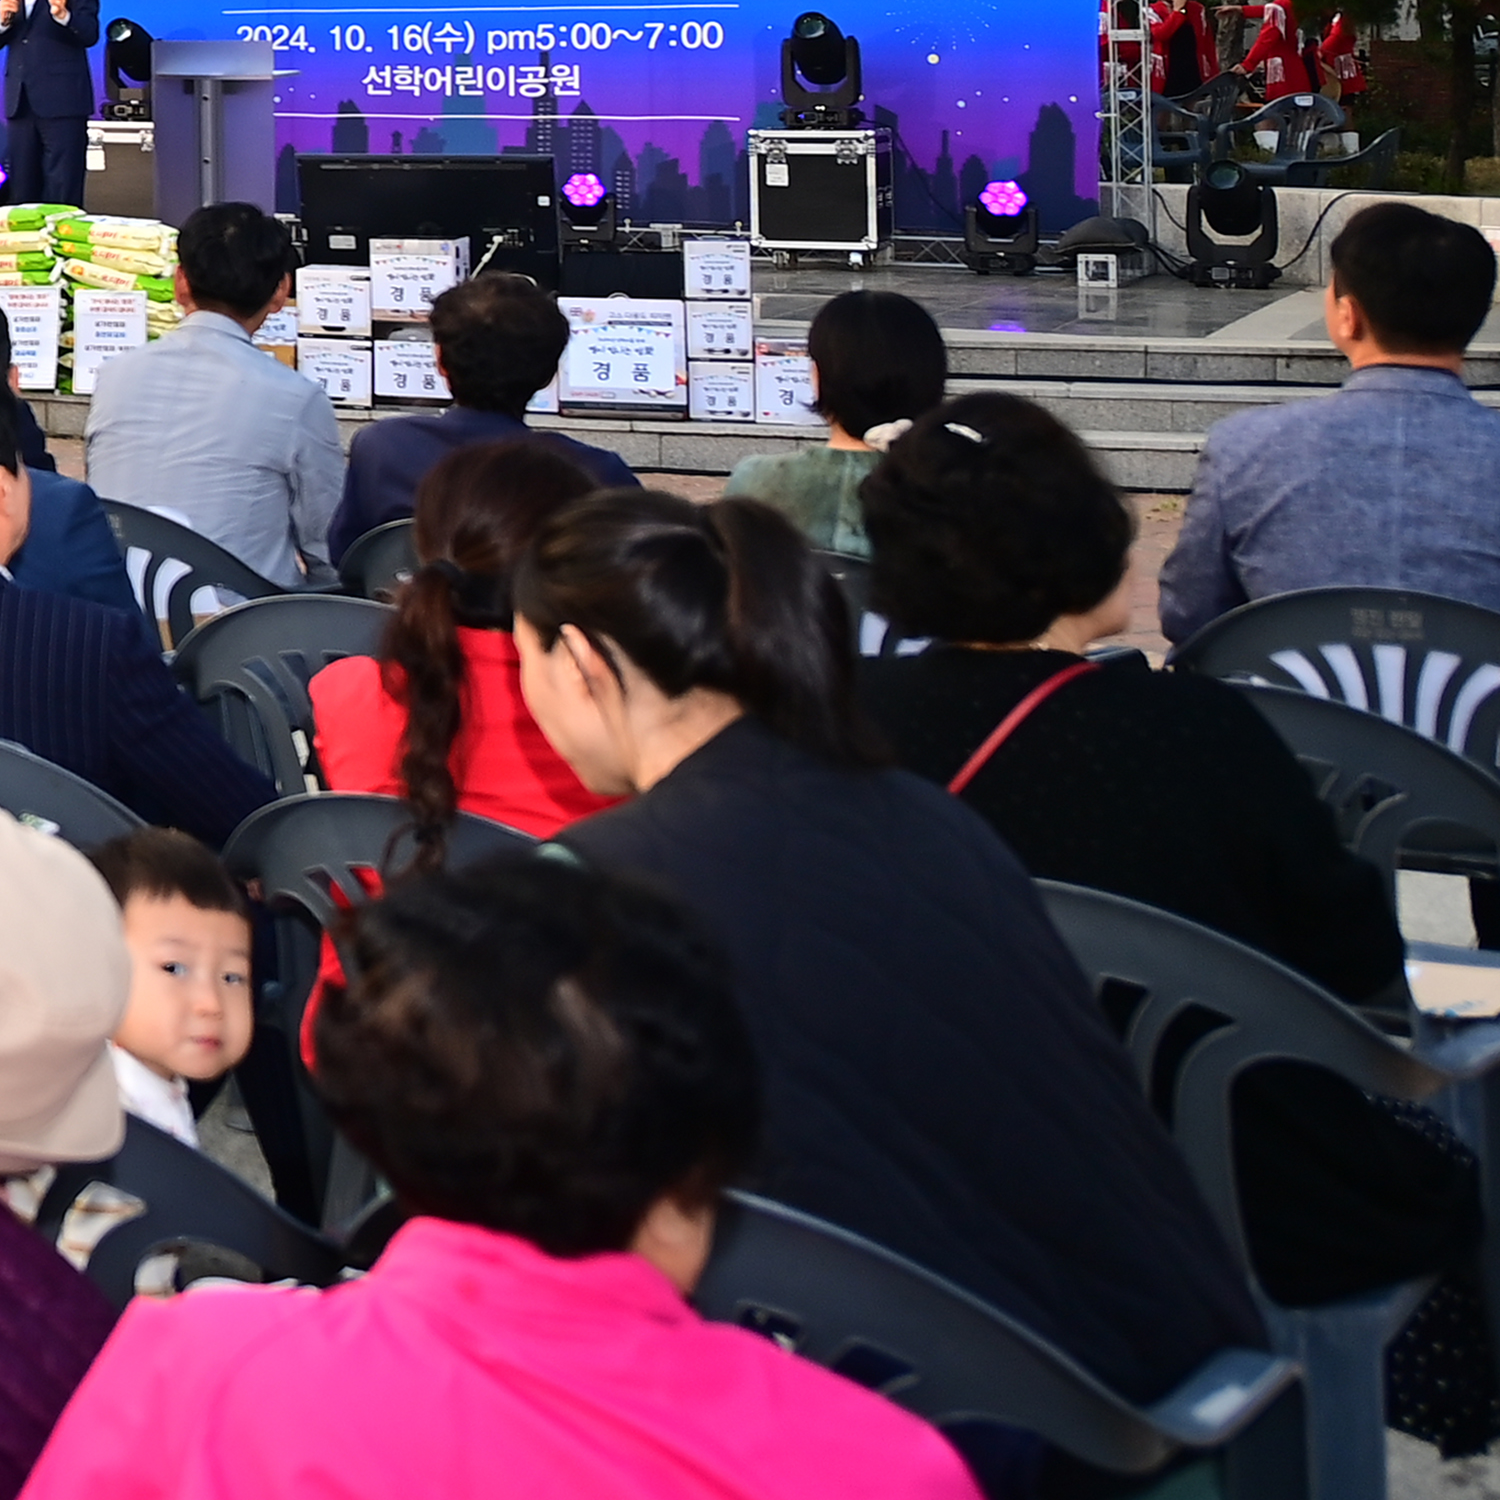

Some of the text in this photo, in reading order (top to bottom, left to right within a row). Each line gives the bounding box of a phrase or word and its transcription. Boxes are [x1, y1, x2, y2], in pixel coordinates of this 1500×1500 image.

[329, 25, 374, 53] 10.
[386, 20, 476, 55] 16(수)
[362, 64, 582, 97] 선학어린이공원
